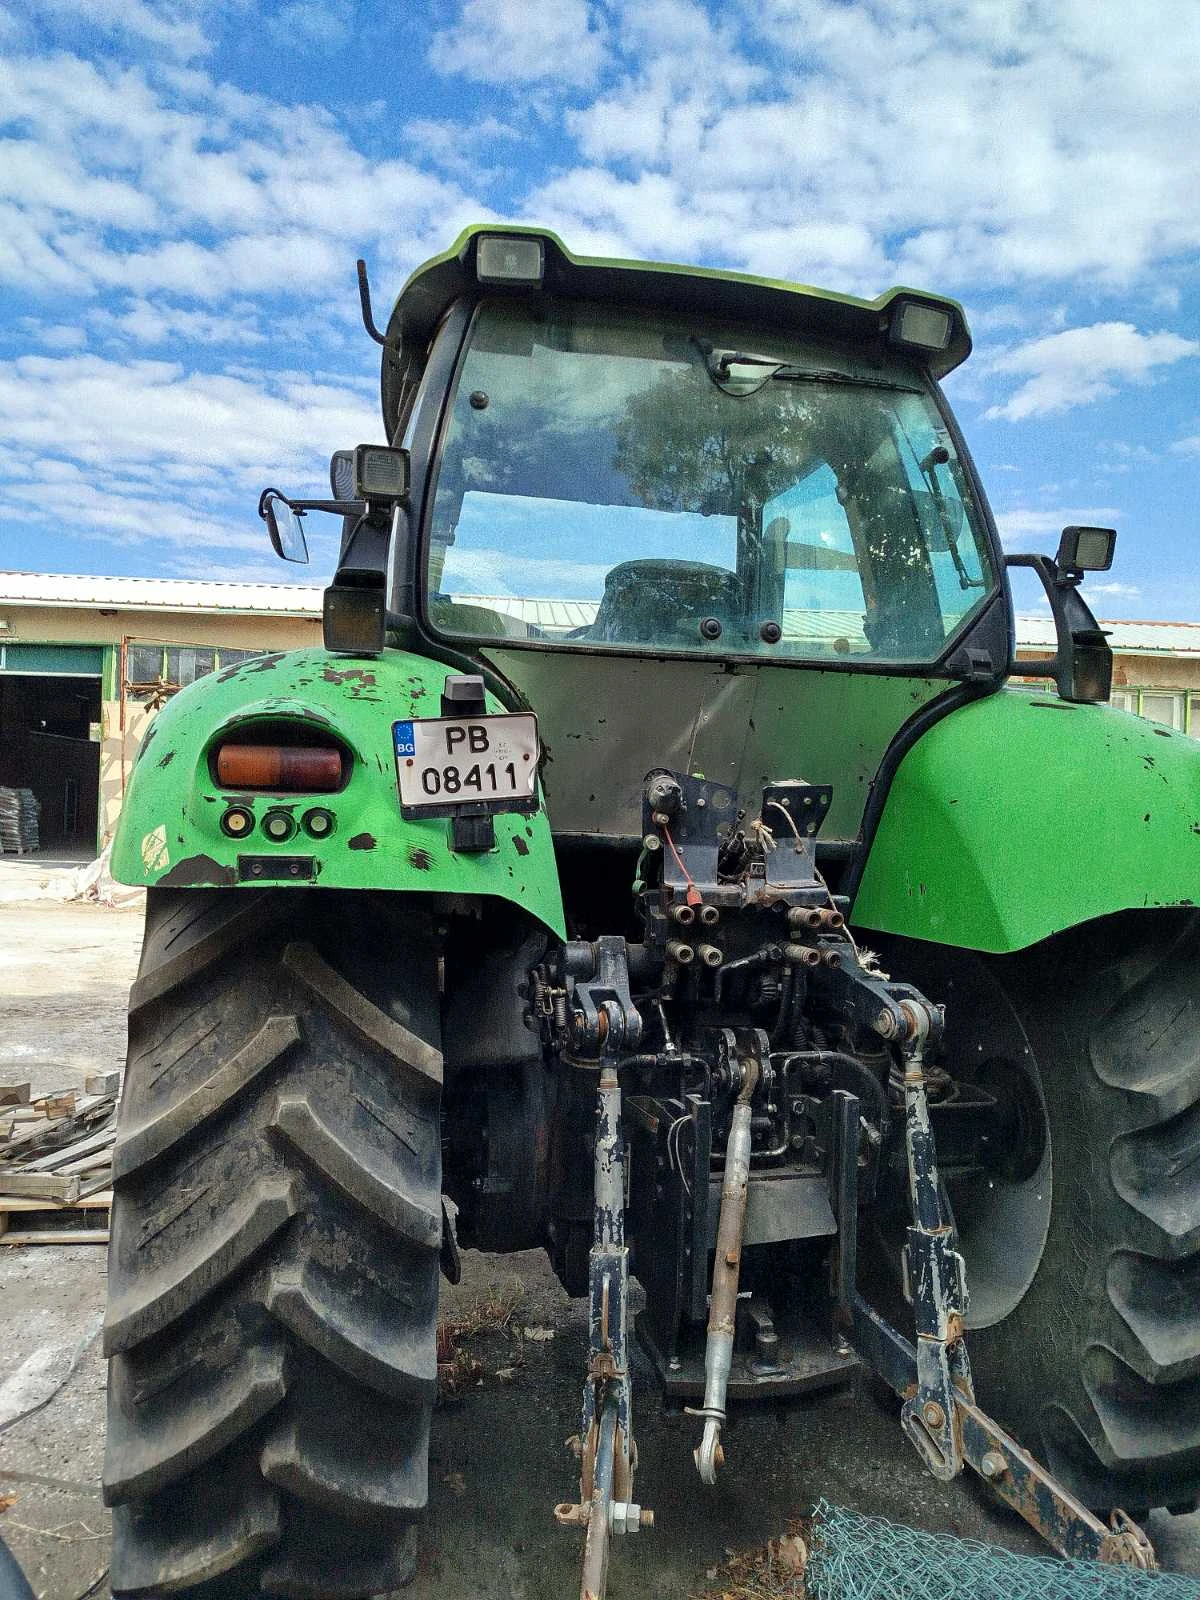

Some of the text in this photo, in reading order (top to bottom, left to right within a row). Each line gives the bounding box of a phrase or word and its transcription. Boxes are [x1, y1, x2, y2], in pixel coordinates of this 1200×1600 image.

[397, 743, 414, 753] BG
[445, 725, 490, 755] PB
[421, 762, 517, 796] 08411
